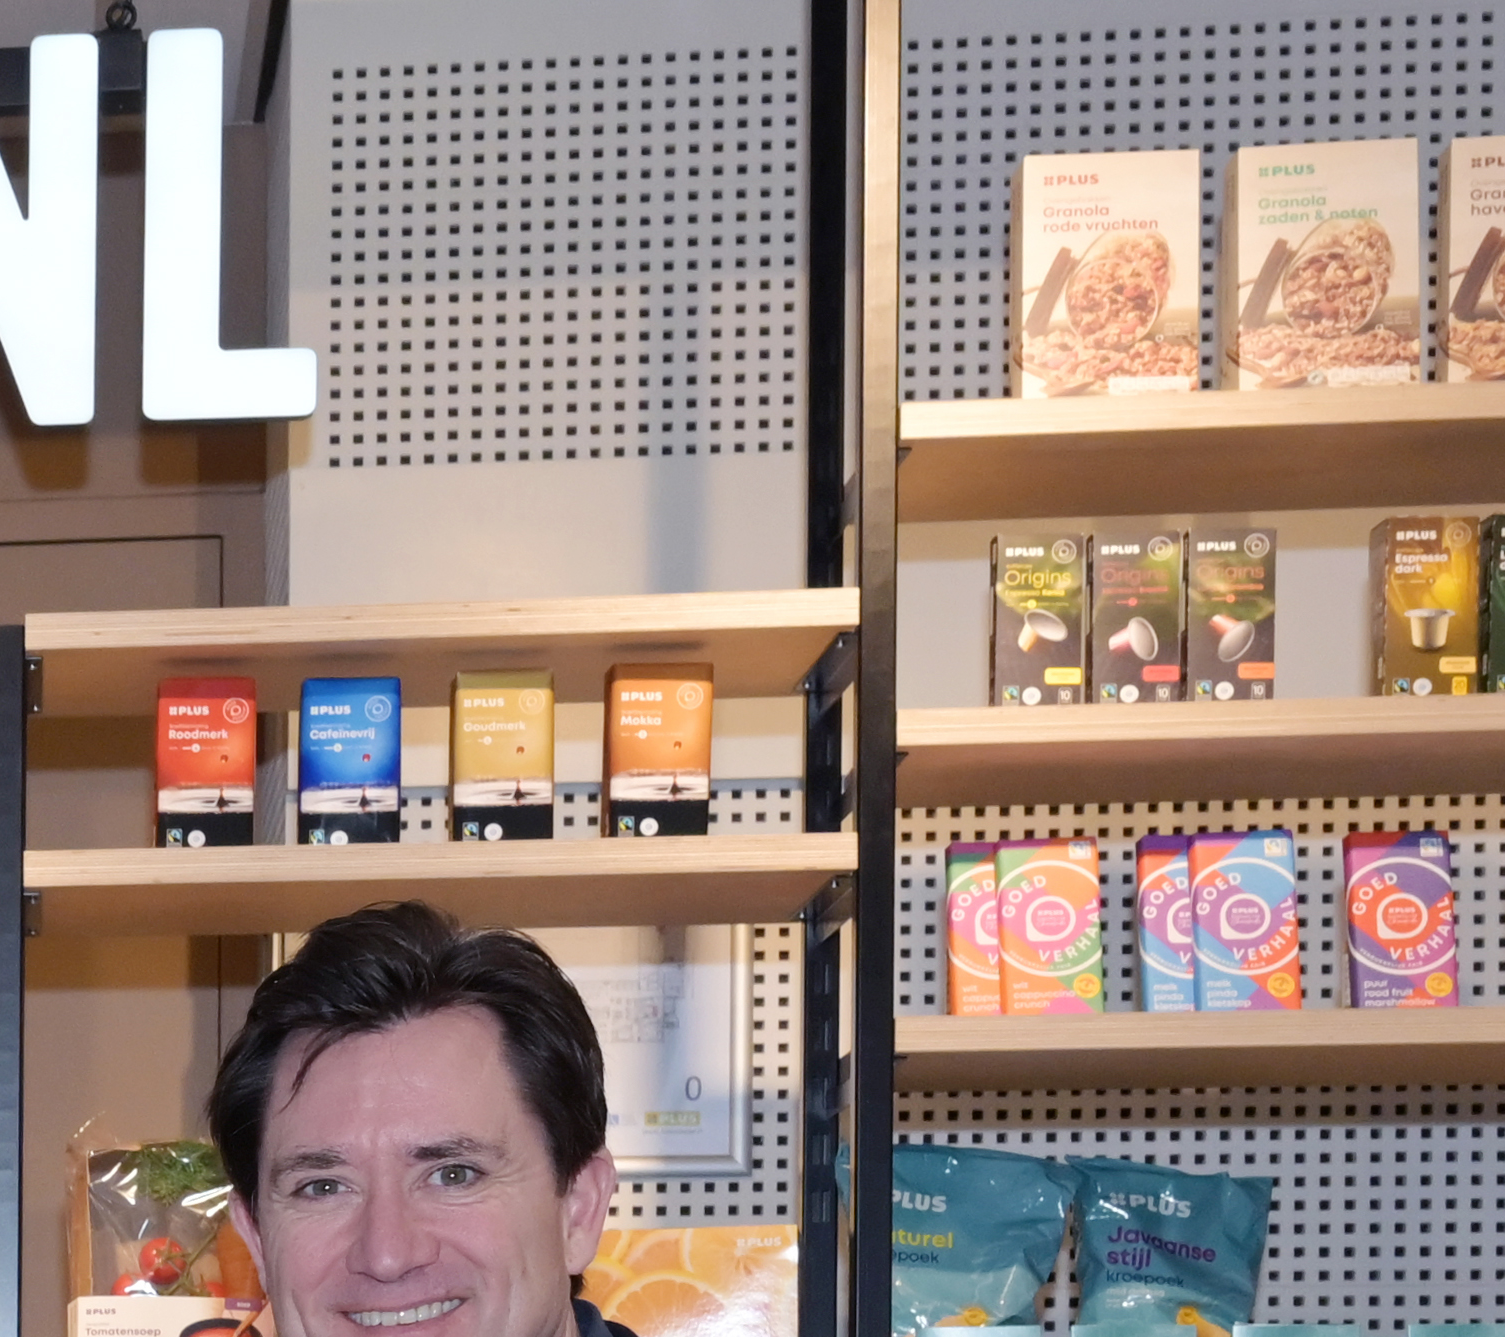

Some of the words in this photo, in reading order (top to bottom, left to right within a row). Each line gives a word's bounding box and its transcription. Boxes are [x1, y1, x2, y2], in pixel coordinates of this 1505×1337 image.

[1272, 164, 1316, 177] PLUS
[1057, 174, 1099, 186] PLUS
[1258, 194, 1326, 209] Granola
[1043, 204, 1109, 218] Granola
[1258, 210, 1310, 225] zaden
[1330, 206, 1378, 220] noten
[1043, 219, 1080, 233] rode
[1085, 218, 1159, 231] vruchten
[1395, 553, 1449, 564] Espresso
[1196, 564, 1264, 584] Origins
[1395, 563, 1423, 574] dark
[1004, 569, 1072, 589] Origins
[630, 692, 662, 701] PLUS
[1060, 690, 1071, 700] 10
[1157, 687, 1168, 697] 10
[1253, 685, 1263, 695] 10
[473, 697, 504, 707] PLUS
[178, 706, 210, 716] PLUS
[319, 705, 351, 716] PLUS
[463, 721, 526, 732] Goudmerk
[620, 715, 662, 726] Mokka
[169, 729, 228, 740] Roodmerk
[951, 878, 996, 922] GOED
[1001, 874, 1047, 919] GOED
[1143, 876, 1189, 919] GOED
[1195, 871, 1241, 915] GOED
[1352, 871, 1398, 915] GOED
[1038, 898, 1099, 964] VERHAAL
[1232, 896, 1295, 962] VERHAAL
[1390, 895, 1453, 961] VERHAAL
[1130, 1195, 1191, 1218] PLUS
[1107, 1224, 1216, 1263] Javaanse
[1107, 1247, 1151, 1271] stijl
[1106, 1269, 1185, 1288] kroepoek
[85, 1328, 161, 1337] Tomatensoep
